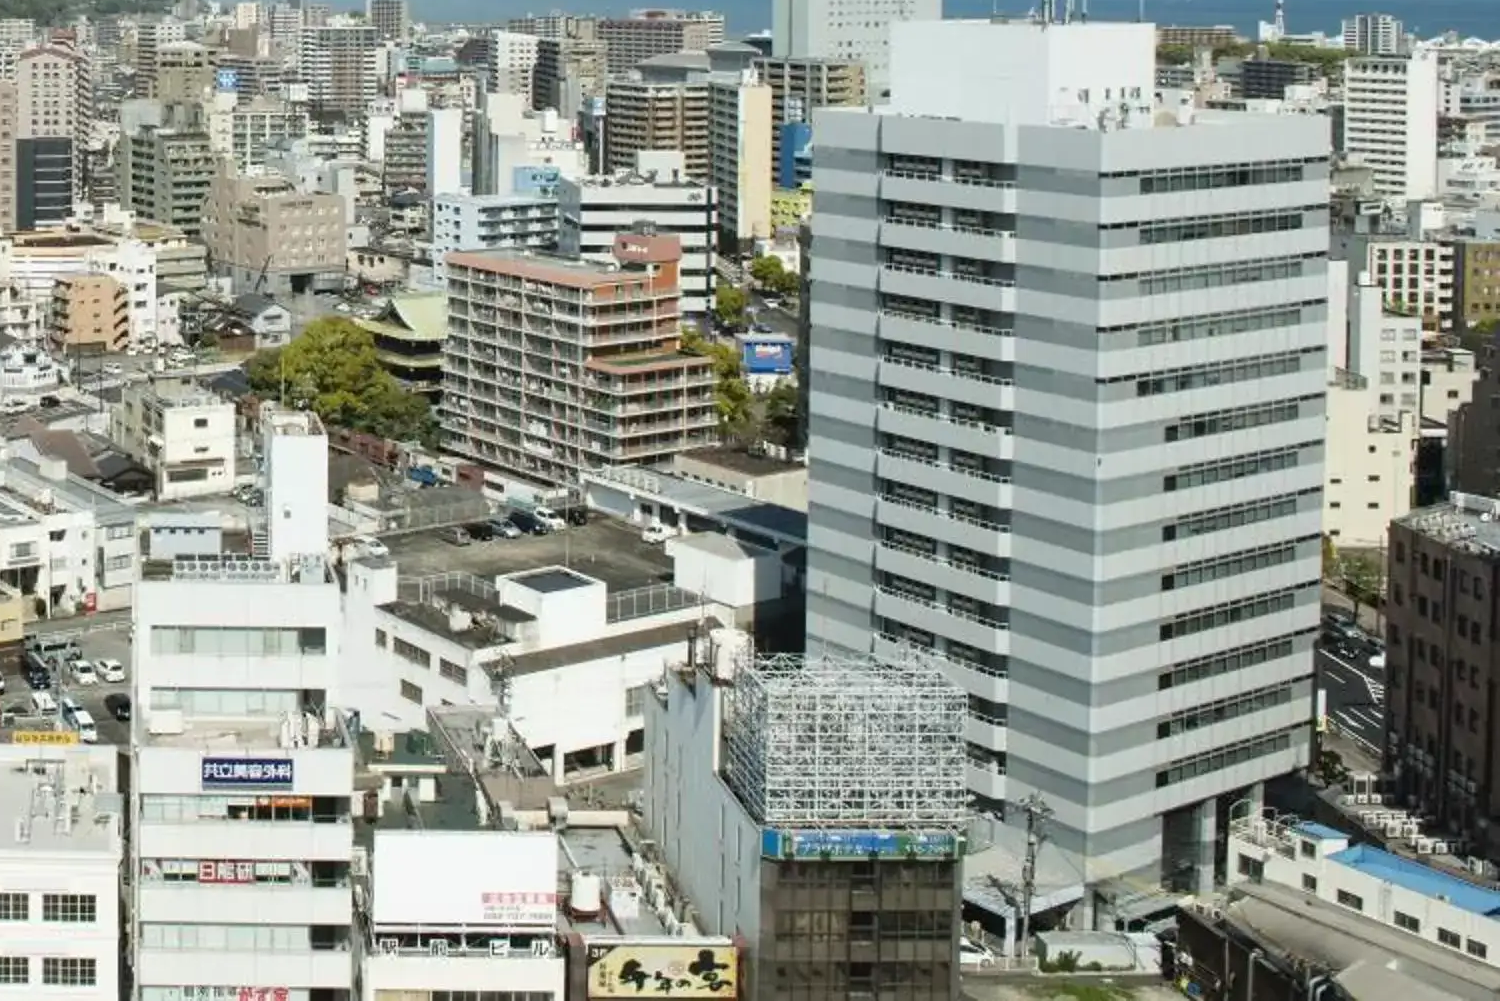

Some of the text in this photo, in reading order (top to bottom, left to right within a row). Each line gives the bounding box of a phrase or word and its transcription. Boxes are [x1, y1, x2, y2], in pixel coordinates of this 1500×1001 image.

[203, 762, 291, 780] 共立美容外科
[199, 861, 254, 880] 日能研
[379, 938, 550, 958] 駅前ビル
[619, 949, 733, 995] 千年の宴
